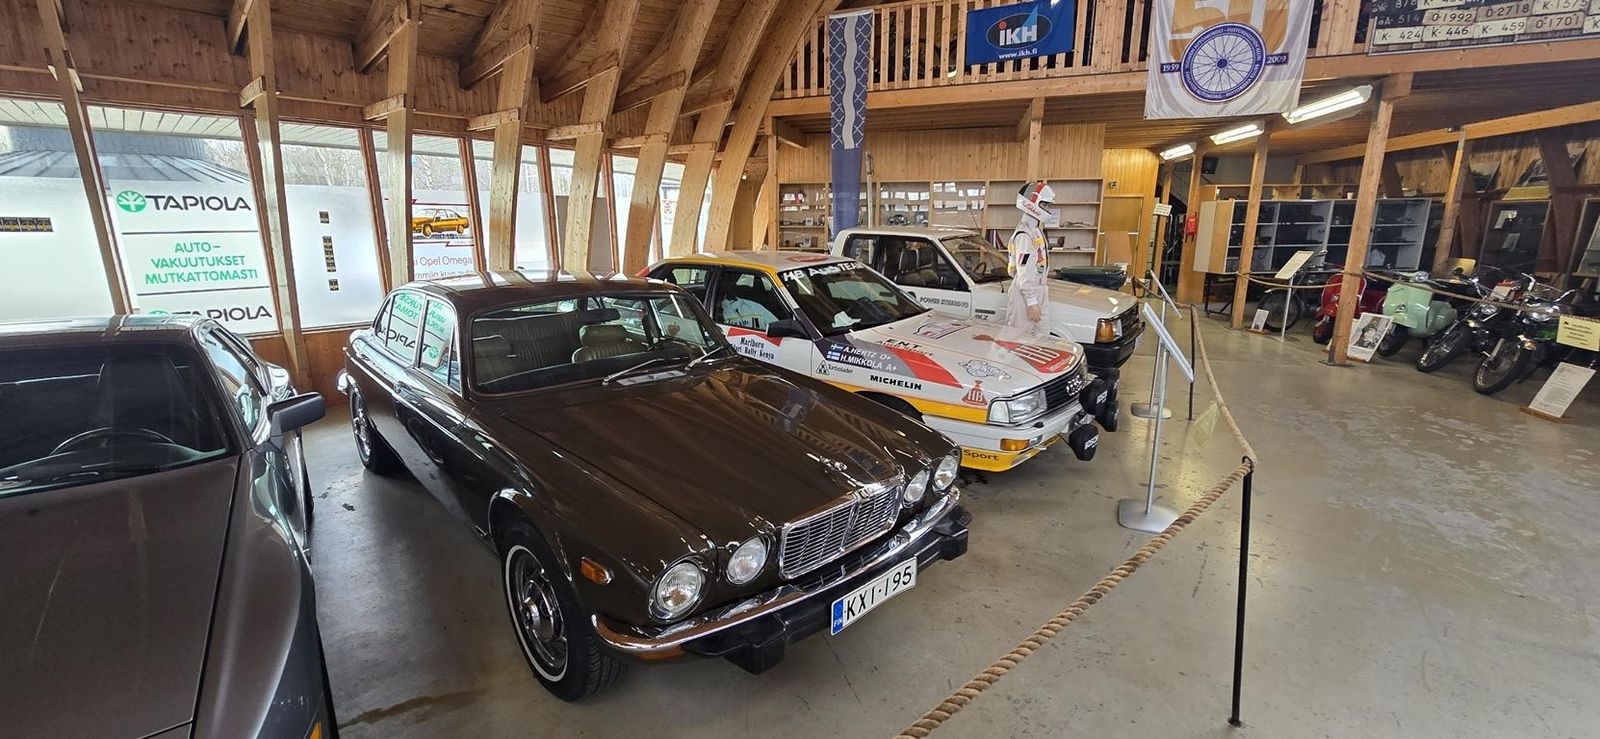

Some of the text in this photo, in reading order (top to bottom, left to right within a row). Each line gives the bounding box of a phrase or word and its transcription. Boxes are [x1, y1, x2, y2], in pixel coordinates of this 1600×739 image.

[998, 48, 1038, 59] www.ikh.fi
[1267, 55, 1287, 64] 2009
[1162, 64, 1179, 72] 1959
[145, 195, 251, 211] TAPIOLA
[175, 242, 221, 253] AUTO-
[151, 255, 245, 268] VAKUUTUKSET
[420, 256, 441, 267] Opel
[442, 256, 473, 266] Omega
[145, 269, 258, 285] MUTKATTOMASTI
[740, 337, 764, 349] Marlboro
[744, 347, 757, 356] Rally
[760, 350, 774, 360] Kenya
[843, 346, 877, 358] A.HERTZ
[840, 354, 883, 369] H.MIKKOLA
[870, 375, 922, 391] MICHELIN
[963, 449, 999, 462] Sport
